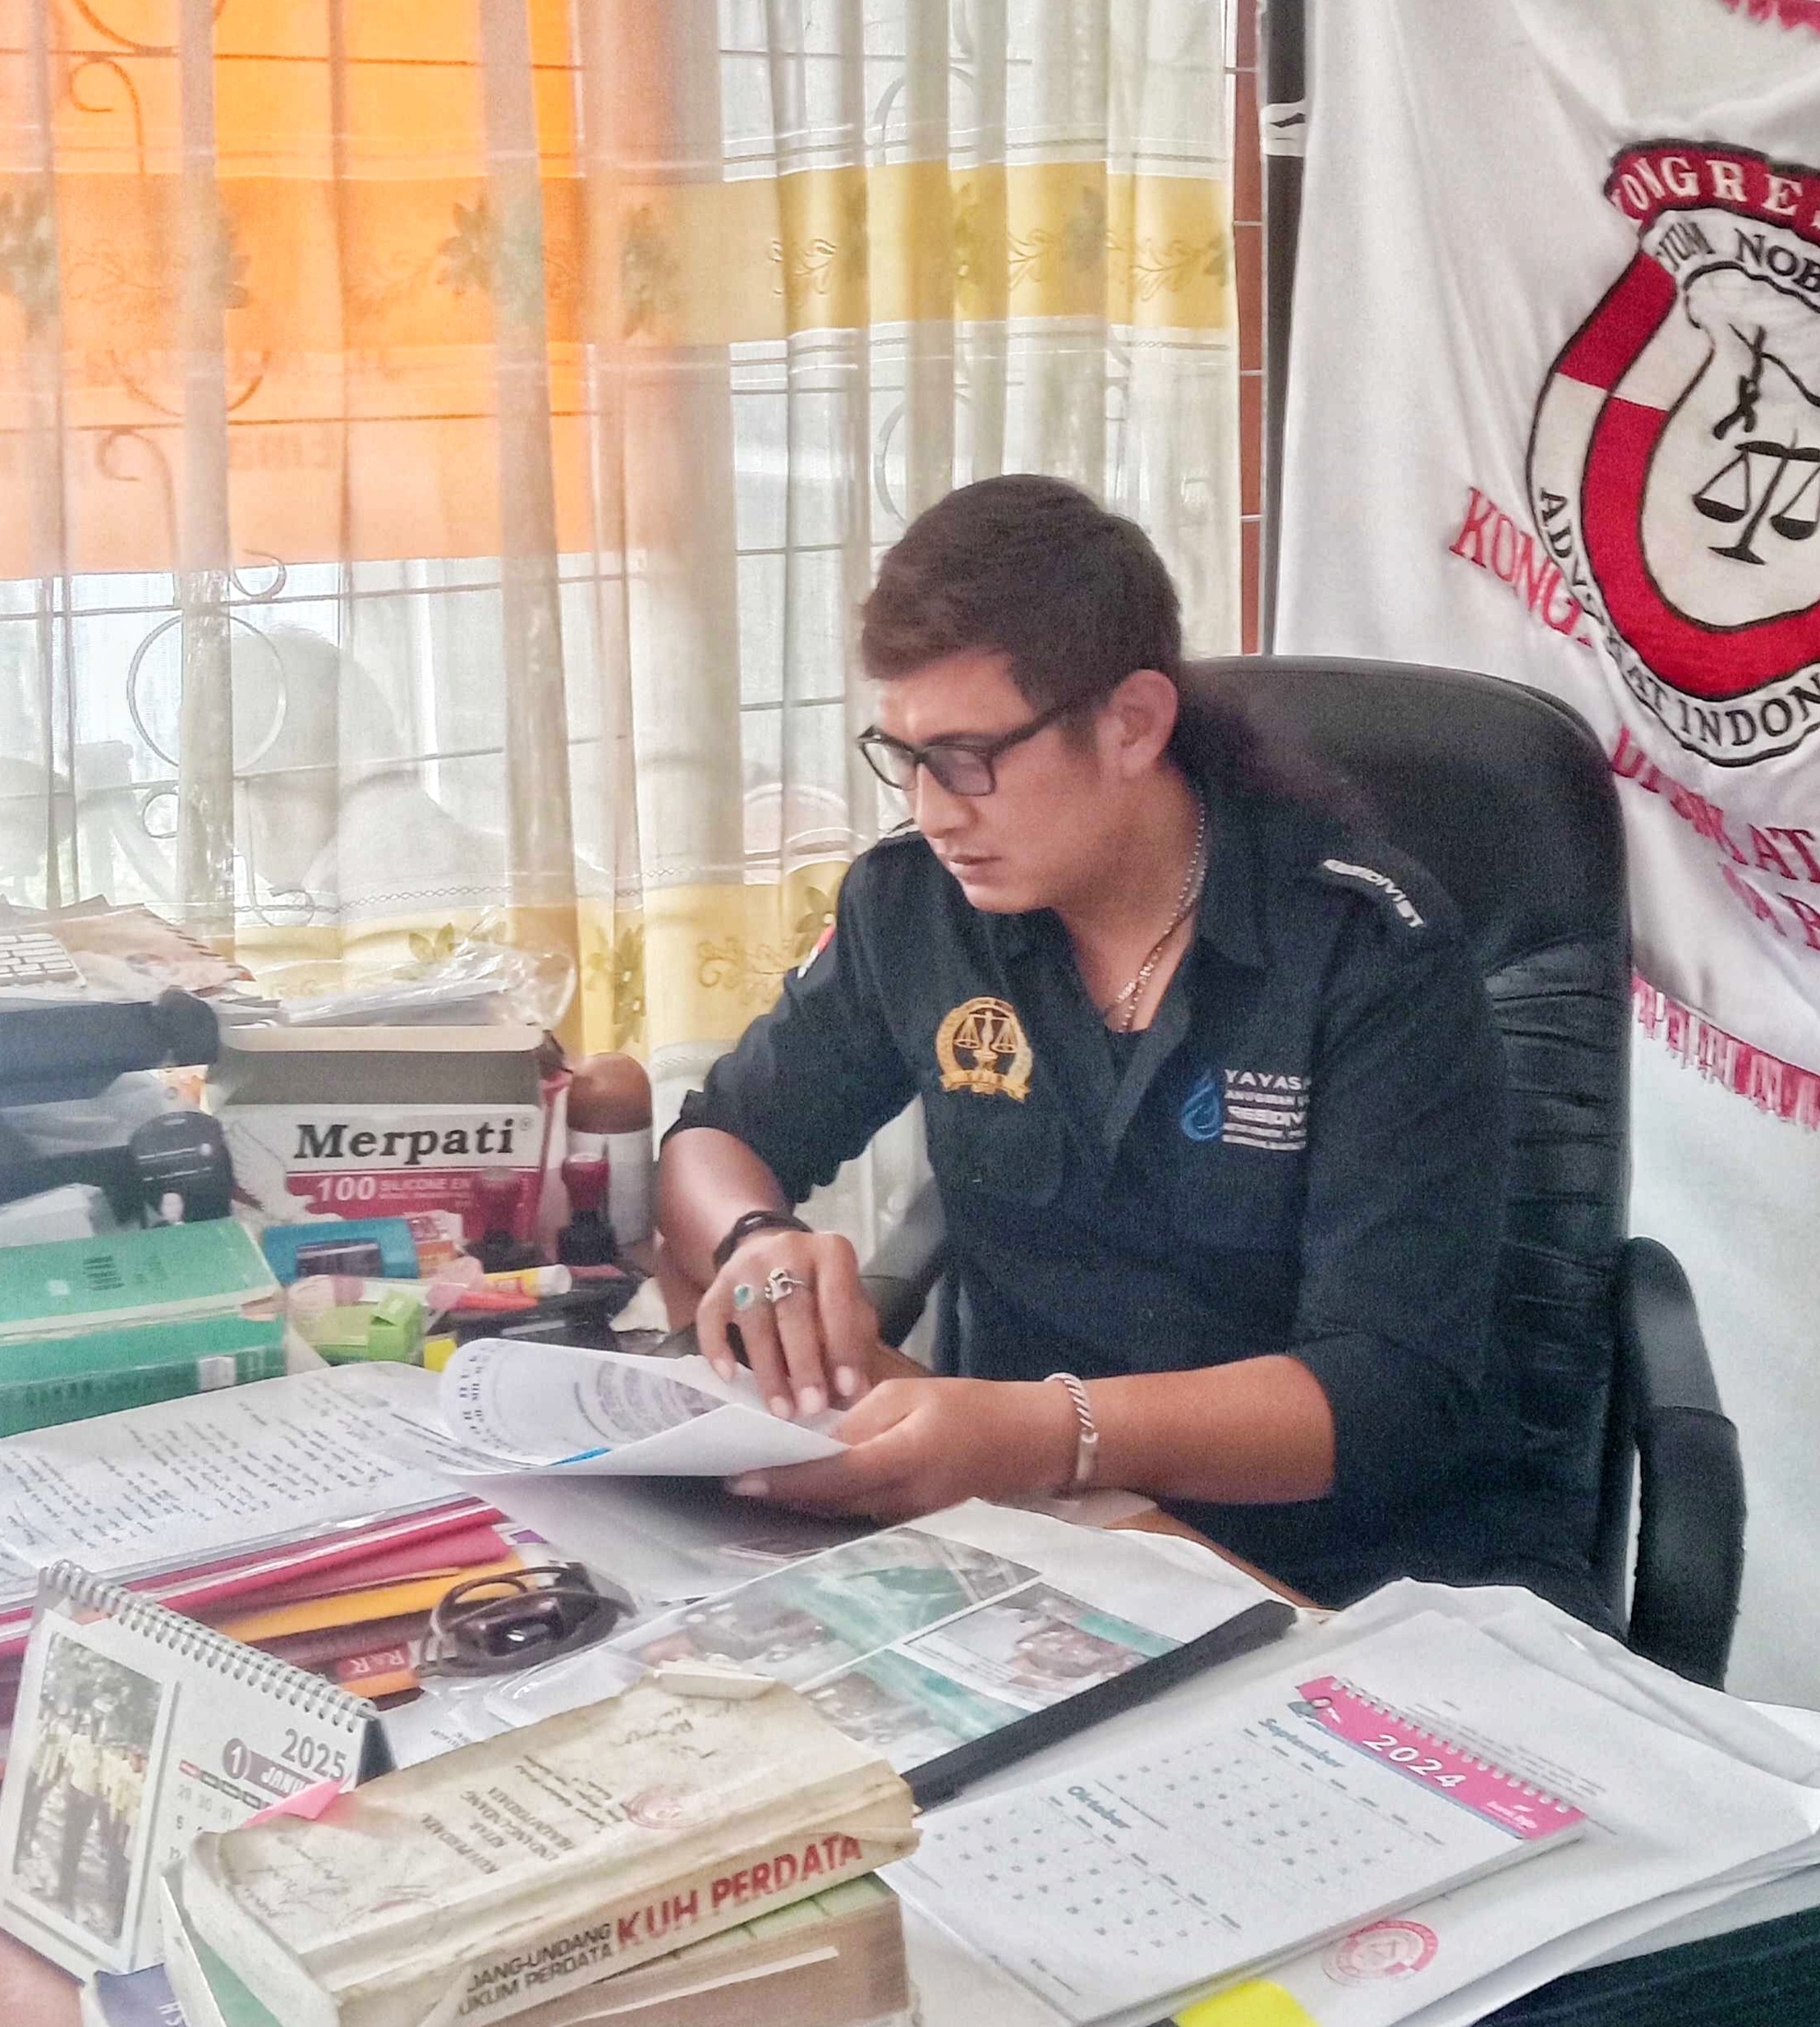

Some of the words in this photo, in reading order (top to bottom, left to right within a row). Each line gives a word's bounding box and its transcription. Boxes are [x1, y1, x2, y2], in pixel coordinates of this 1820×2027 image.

[1449, 486, 1593, 649] KONG
[293, 1118, 516, 1165] Merpati
[317, 1177, 376, 1202] 100
[230, 1746, 243, 1775] 1
[281, 1728, 347, 1780] 2025
[1363, 1734, 1466, 1789] 2024
[617, 1891, 700, 1948] KUH
[710, 1832, 864, 1910] PERDATA
